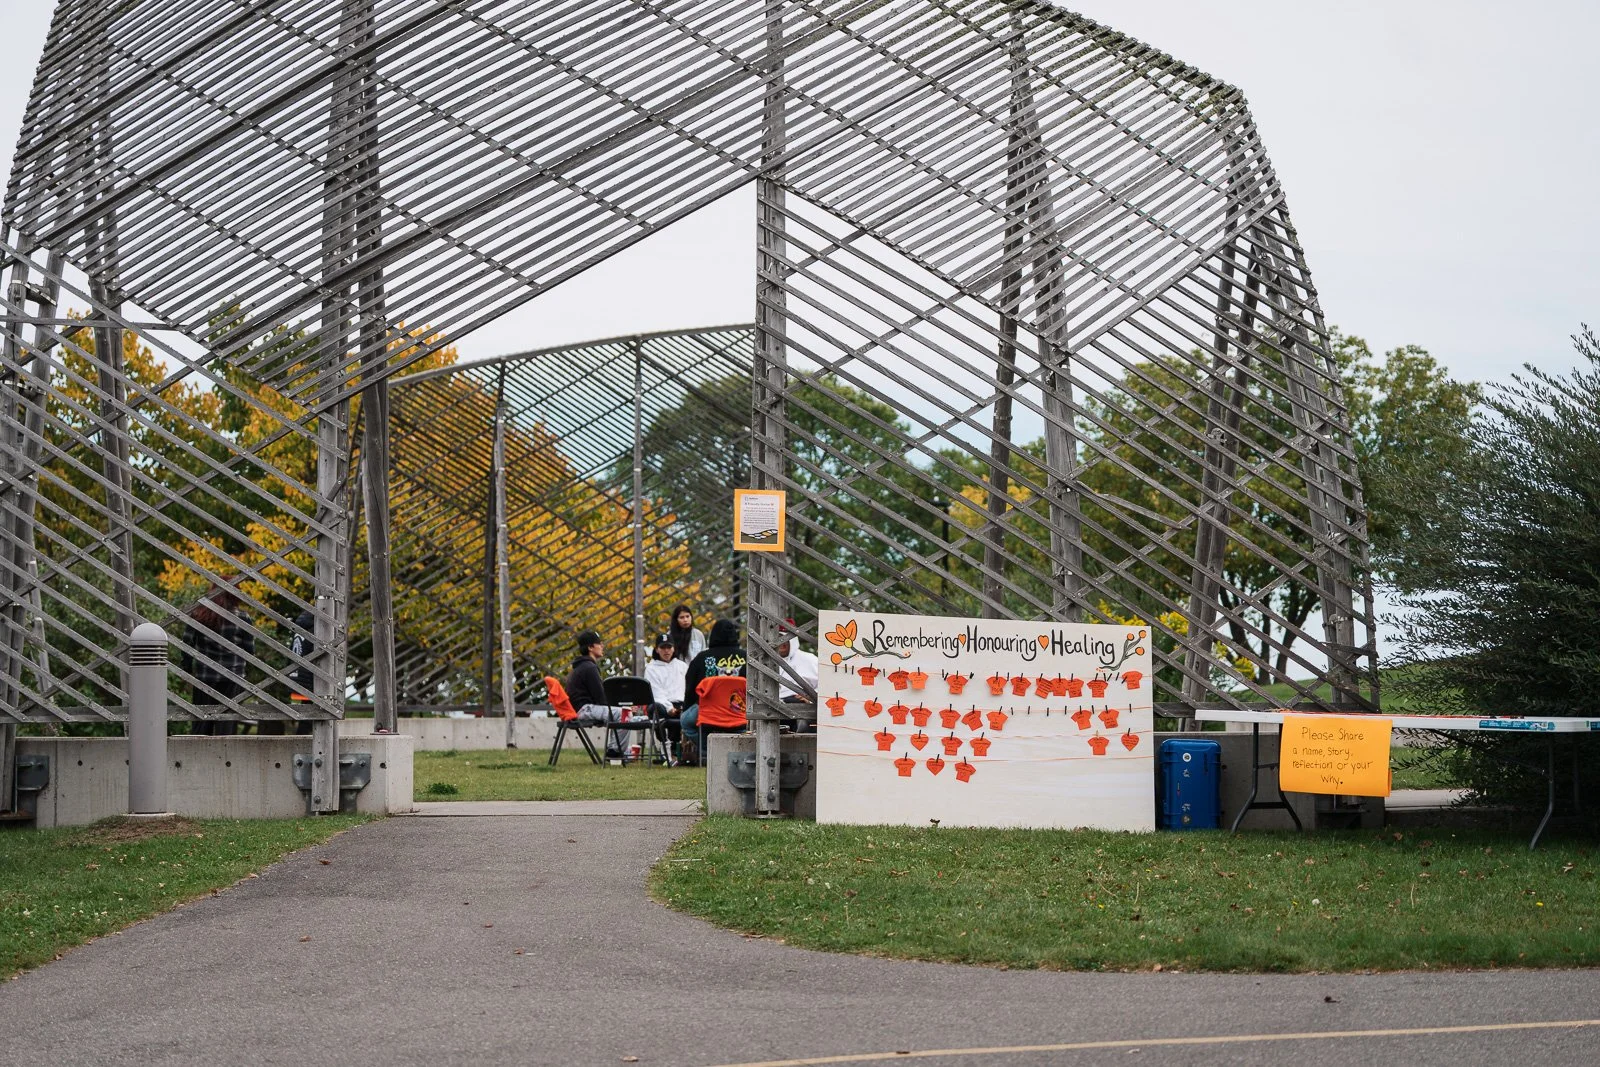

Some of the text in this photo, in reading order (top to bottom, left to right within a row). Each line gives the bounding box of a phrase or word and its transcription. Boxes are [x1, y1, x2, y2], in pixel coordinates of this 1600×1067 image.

[873, 620, 1115, 665] Remembering Honouring Healing
[1302, 727, 1364, 740] Please Share
[1302, 747, 1326, 757] name,
[1292, 760, 1373, 774] reflection or your
